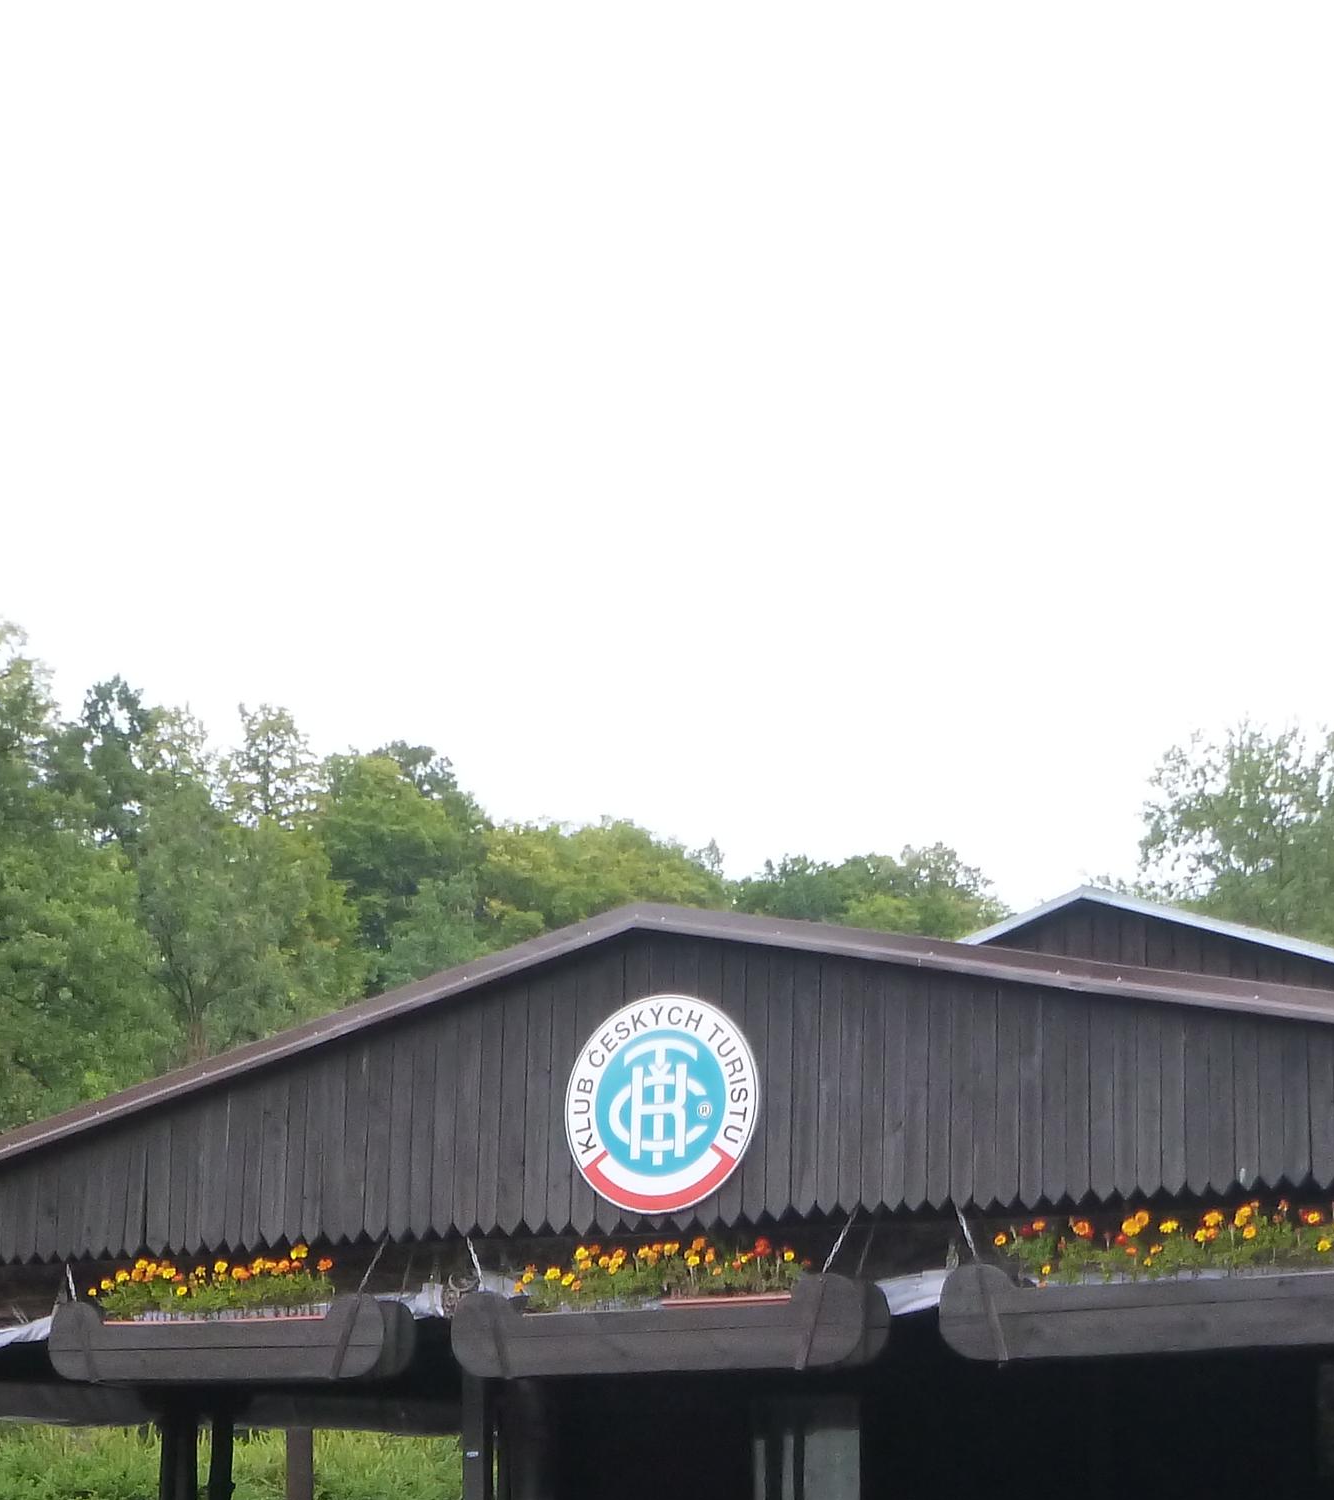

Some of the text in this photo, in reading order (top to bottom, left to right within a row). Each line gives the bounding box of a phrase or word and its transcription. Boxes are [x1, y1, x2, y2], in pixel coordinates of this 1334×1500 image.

[573, 1003, 749, 1155] KLUB ČESKÝCH TURISTŮ
